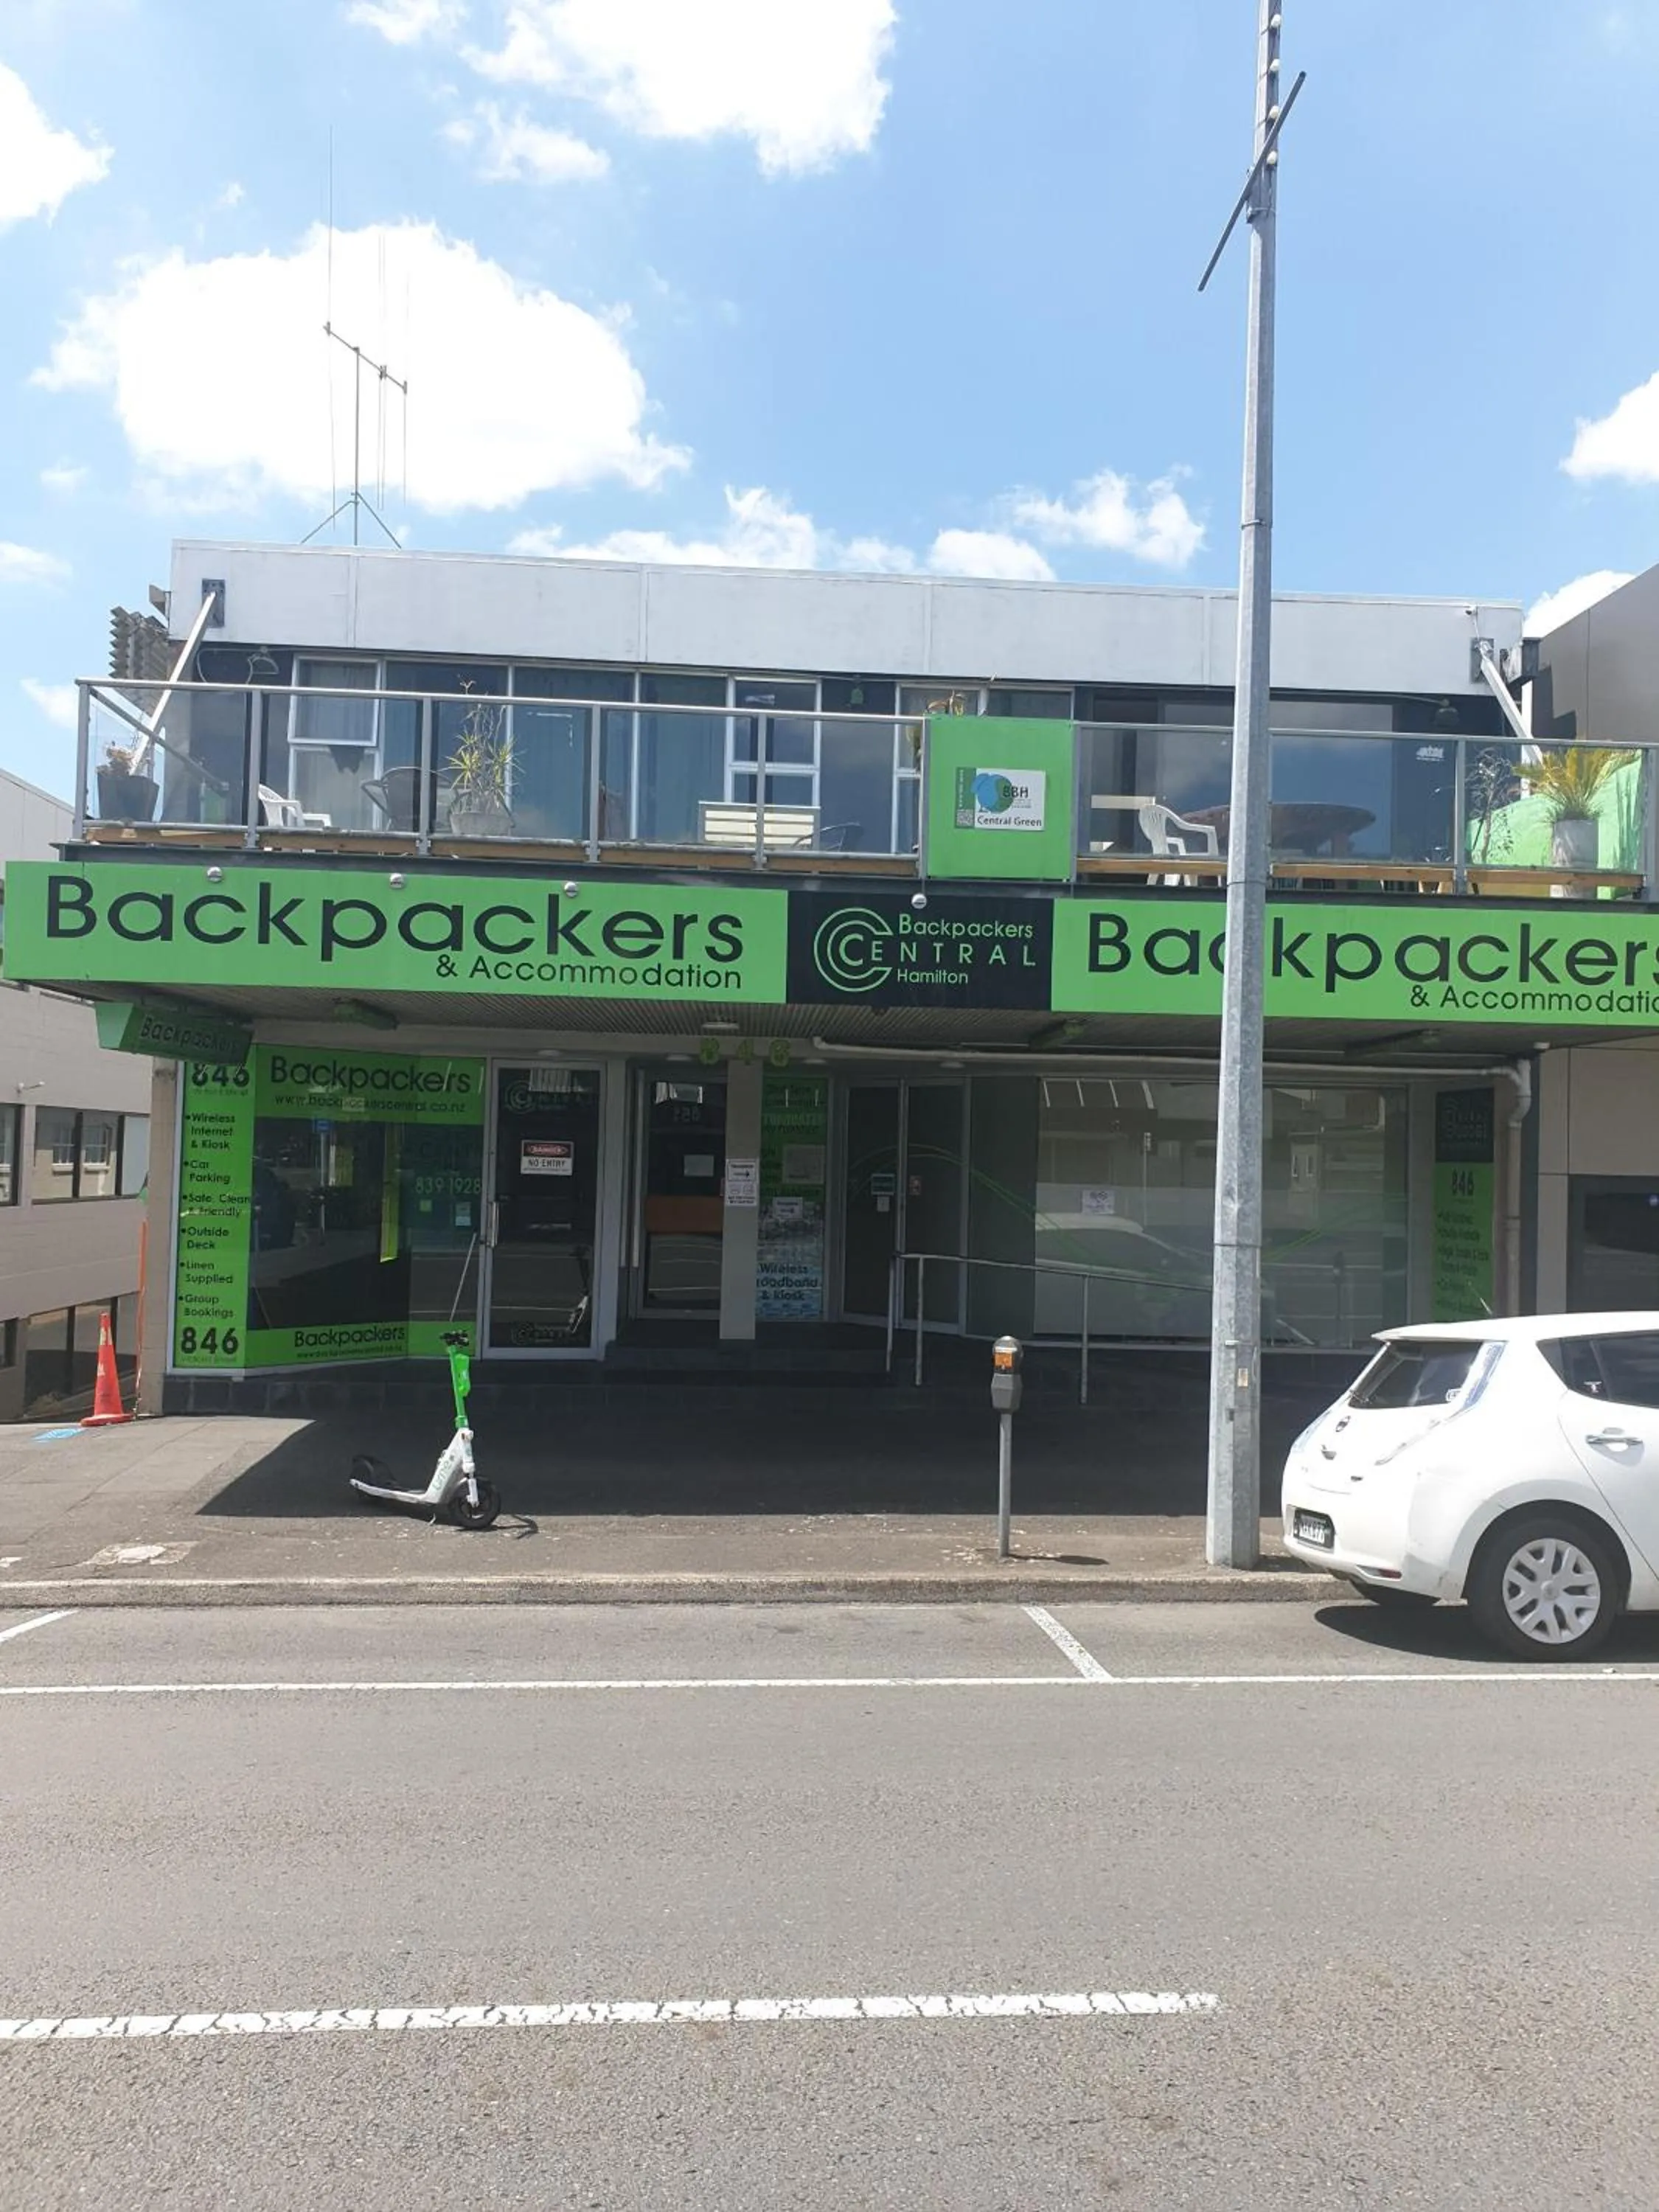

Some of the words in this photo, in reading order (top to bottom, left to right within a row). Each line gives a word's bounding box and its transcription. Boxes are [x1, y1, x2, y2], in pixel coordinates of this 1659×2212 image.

[1003, 785, 1029, 799] BBH
[977, 815, 1012, 826] Central
[1014, 816, 1042, 827] Green
[46, 874, 743, 963] Backpackers
[899, 914, 1034, 939] Backpackers
[1088, 913, 1659, 993] Bakpacker
[437, 954, 458, 978] &
[470, 956, 742, 989] Accommodation
[897, 968, 968, 984] Hamilton
[1410, 984, 1430, 1009] &
[192, 1061, 250, 1088] 846
[271, 1054, 471, 1094] Backpackers
[191, 1113, 235, 1124] Wireless
[191, 1126, 234, 1136] Internet
[201, 1139, 230, 1150] Kiosk
[189, 1160, 209, 1169] Car
[189, 1173, 231, 1185] Parking
[1452, 1169, 1475, 1196] 846
[449, 1177, 481, 1195] 1928
[188, 1194, 212, 1203] Safe
[187, 1226, 230, 1237] Outside
[187, 1239, 215, 1249] Deck
[186, 1261, 215, 1270] Linen
[759, 1262, 808, 1274] Wireless
[185, 1273, 234, 1285] Supplied
[756, 1276, 818, 1287] roadband
[184, 1294, 220, 1305] Group
[184, 1307, 234, 1319] Bookings
[181, 1326, 239, 1354] 846
[294, 1326, 406, 1348] Backpackers
